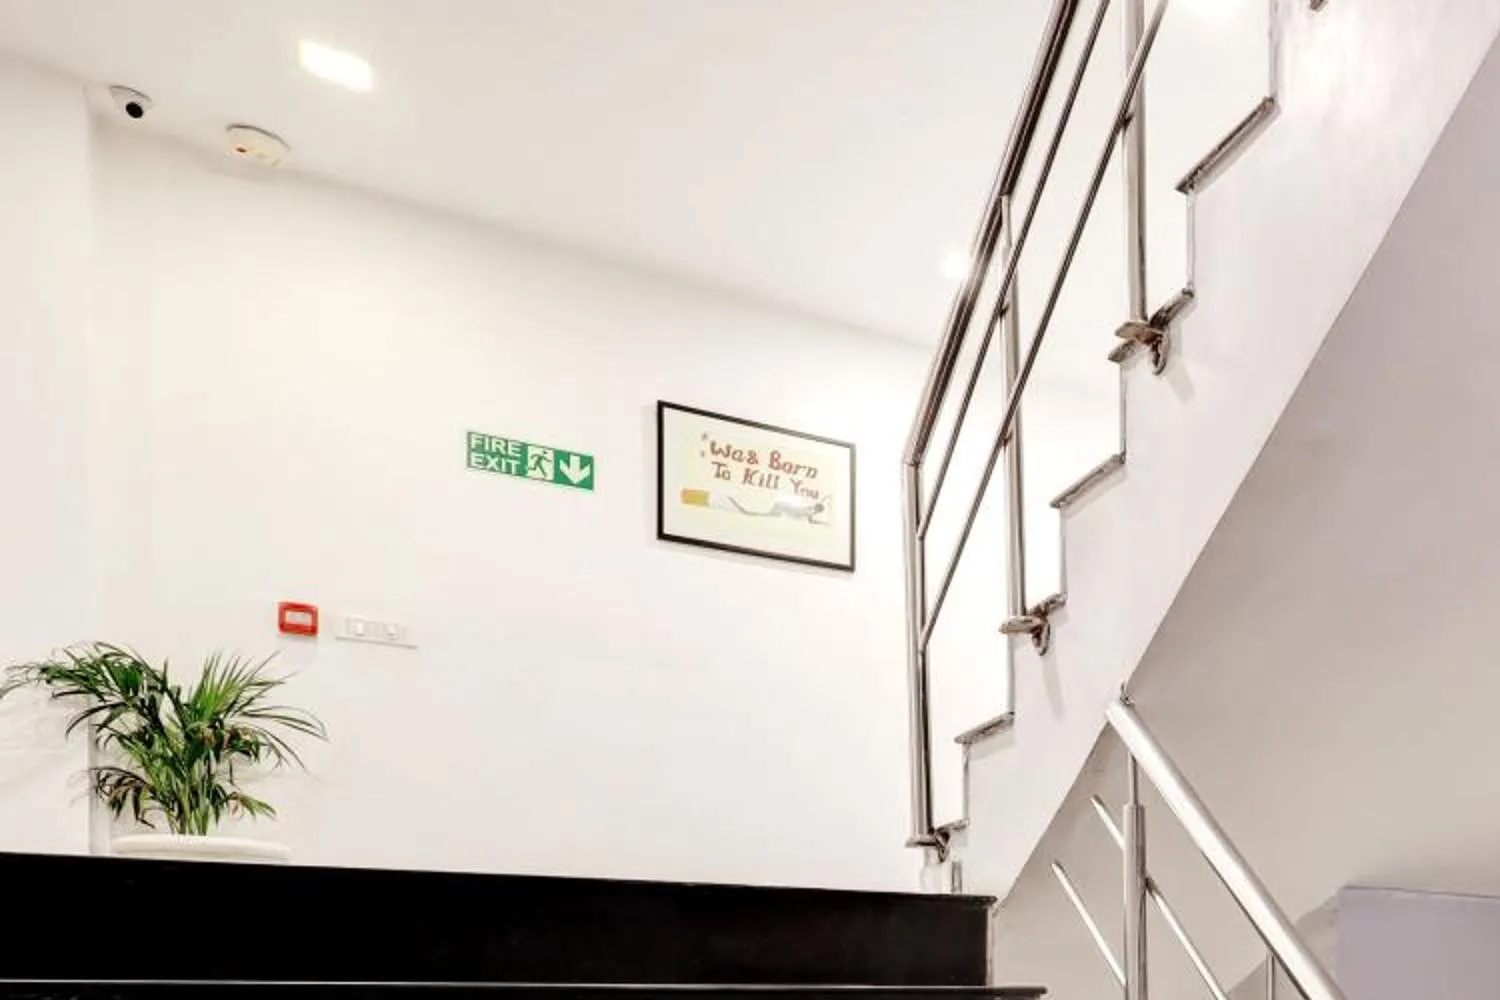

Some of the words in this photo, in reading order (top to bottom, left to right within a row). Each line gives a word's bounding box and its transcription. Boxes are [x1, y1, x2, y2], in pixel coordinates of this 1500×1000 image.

[470, 434, 522, 457] FIRE
[470, 453, 521, 475] EXIT
[711, 461, 732, 482] To
[742, 467, 781, 490] Kill
